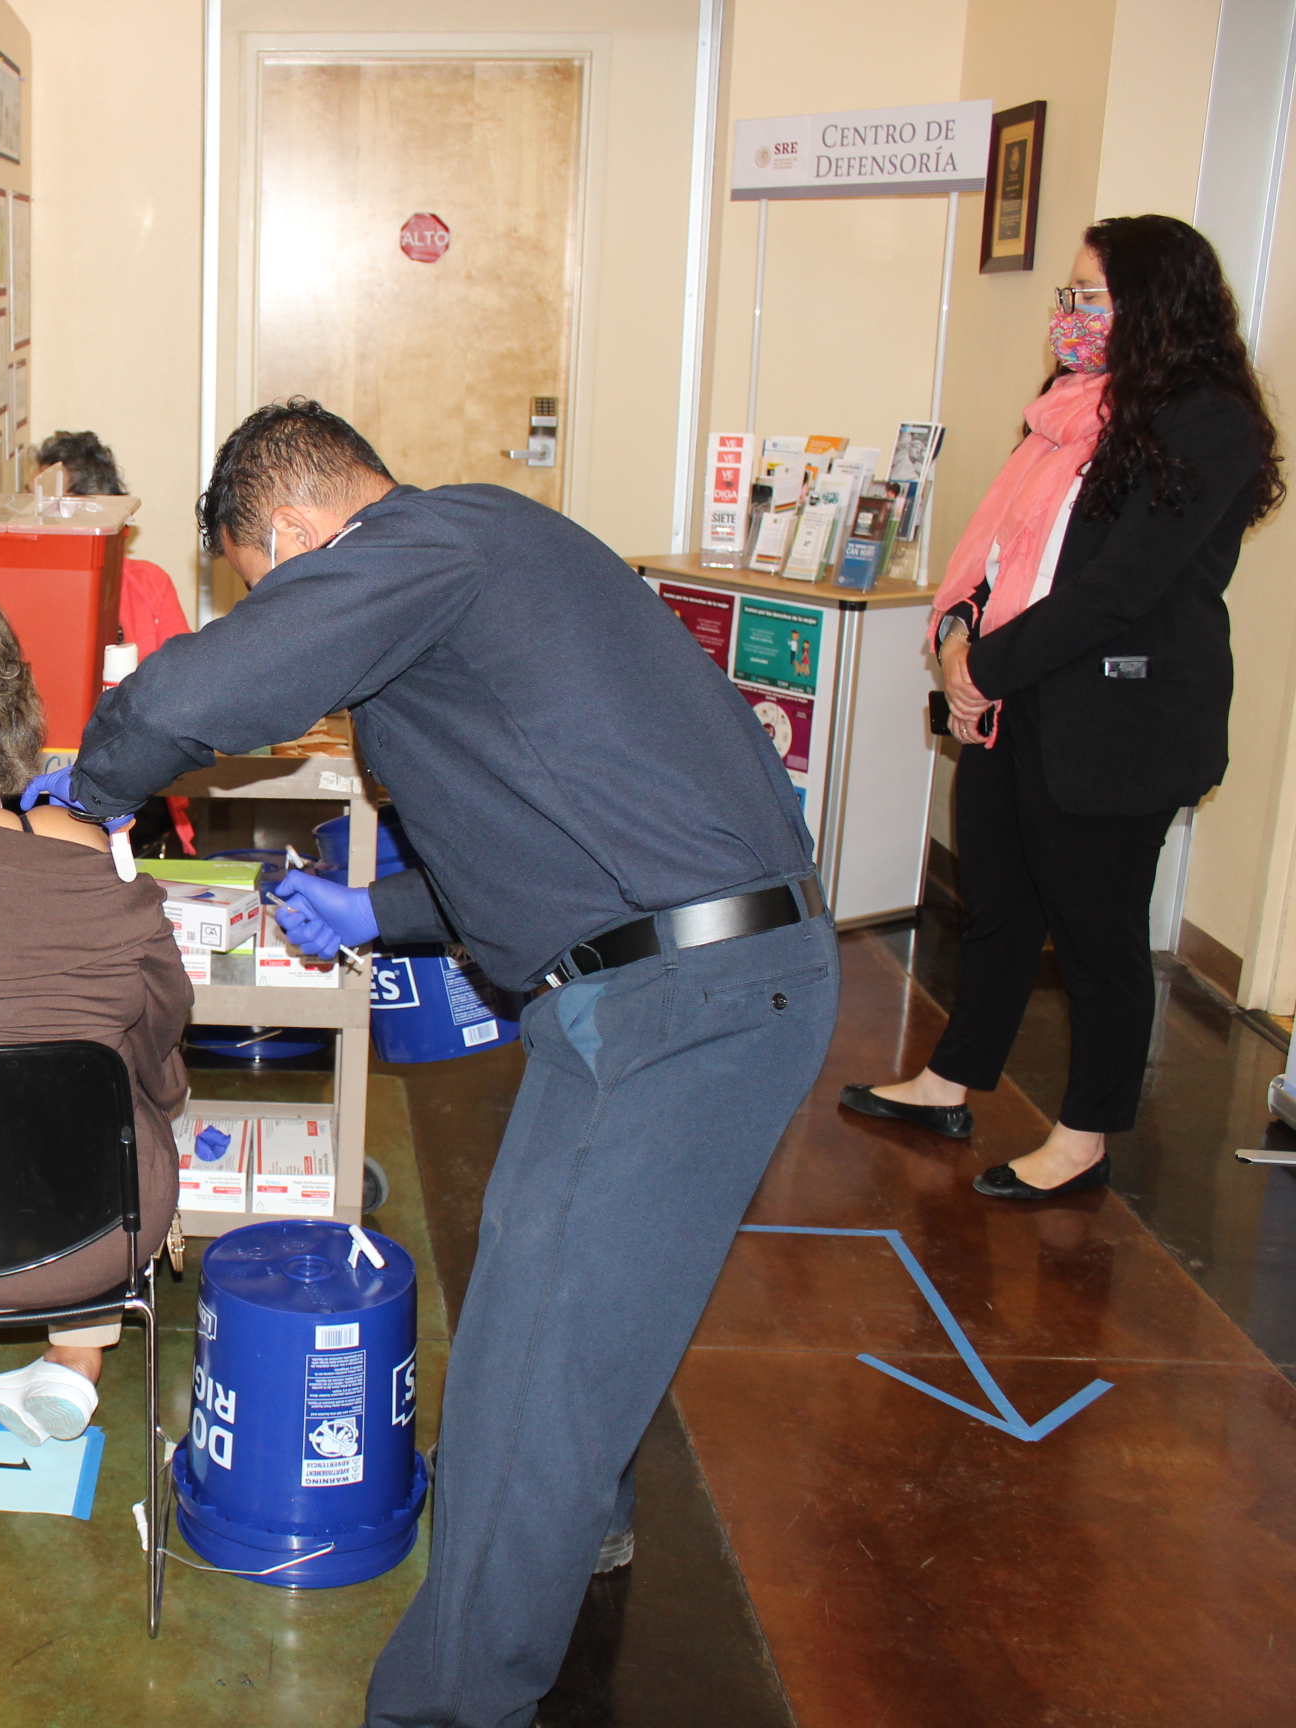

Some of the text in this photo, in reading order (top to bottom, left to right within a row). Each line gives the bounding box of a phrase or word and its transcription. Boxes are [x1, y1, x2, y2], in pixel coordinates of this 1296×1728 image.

[821, 119, 956, 149] CENTRO DE
[774, 142, 798, 155] SRE
[814, 146, 958, 178] DEFENSORÍA
[401, 230, 449, 247] ALTO
[724, 439, 737, 447] VE
[723, 454, 735, 462] VE
[721, 470, 734, 478] VE
[714, 489, 738, 498] DIGA
[711, 513, 736, 523] SIETE
[193, 1362, 236, 1425] RIG
[192, 1407, 233, 1471] DO
[306, 1460, 350, 1468] ADVERTENCIA
[305, 1476, 350, 1484] WARNING
